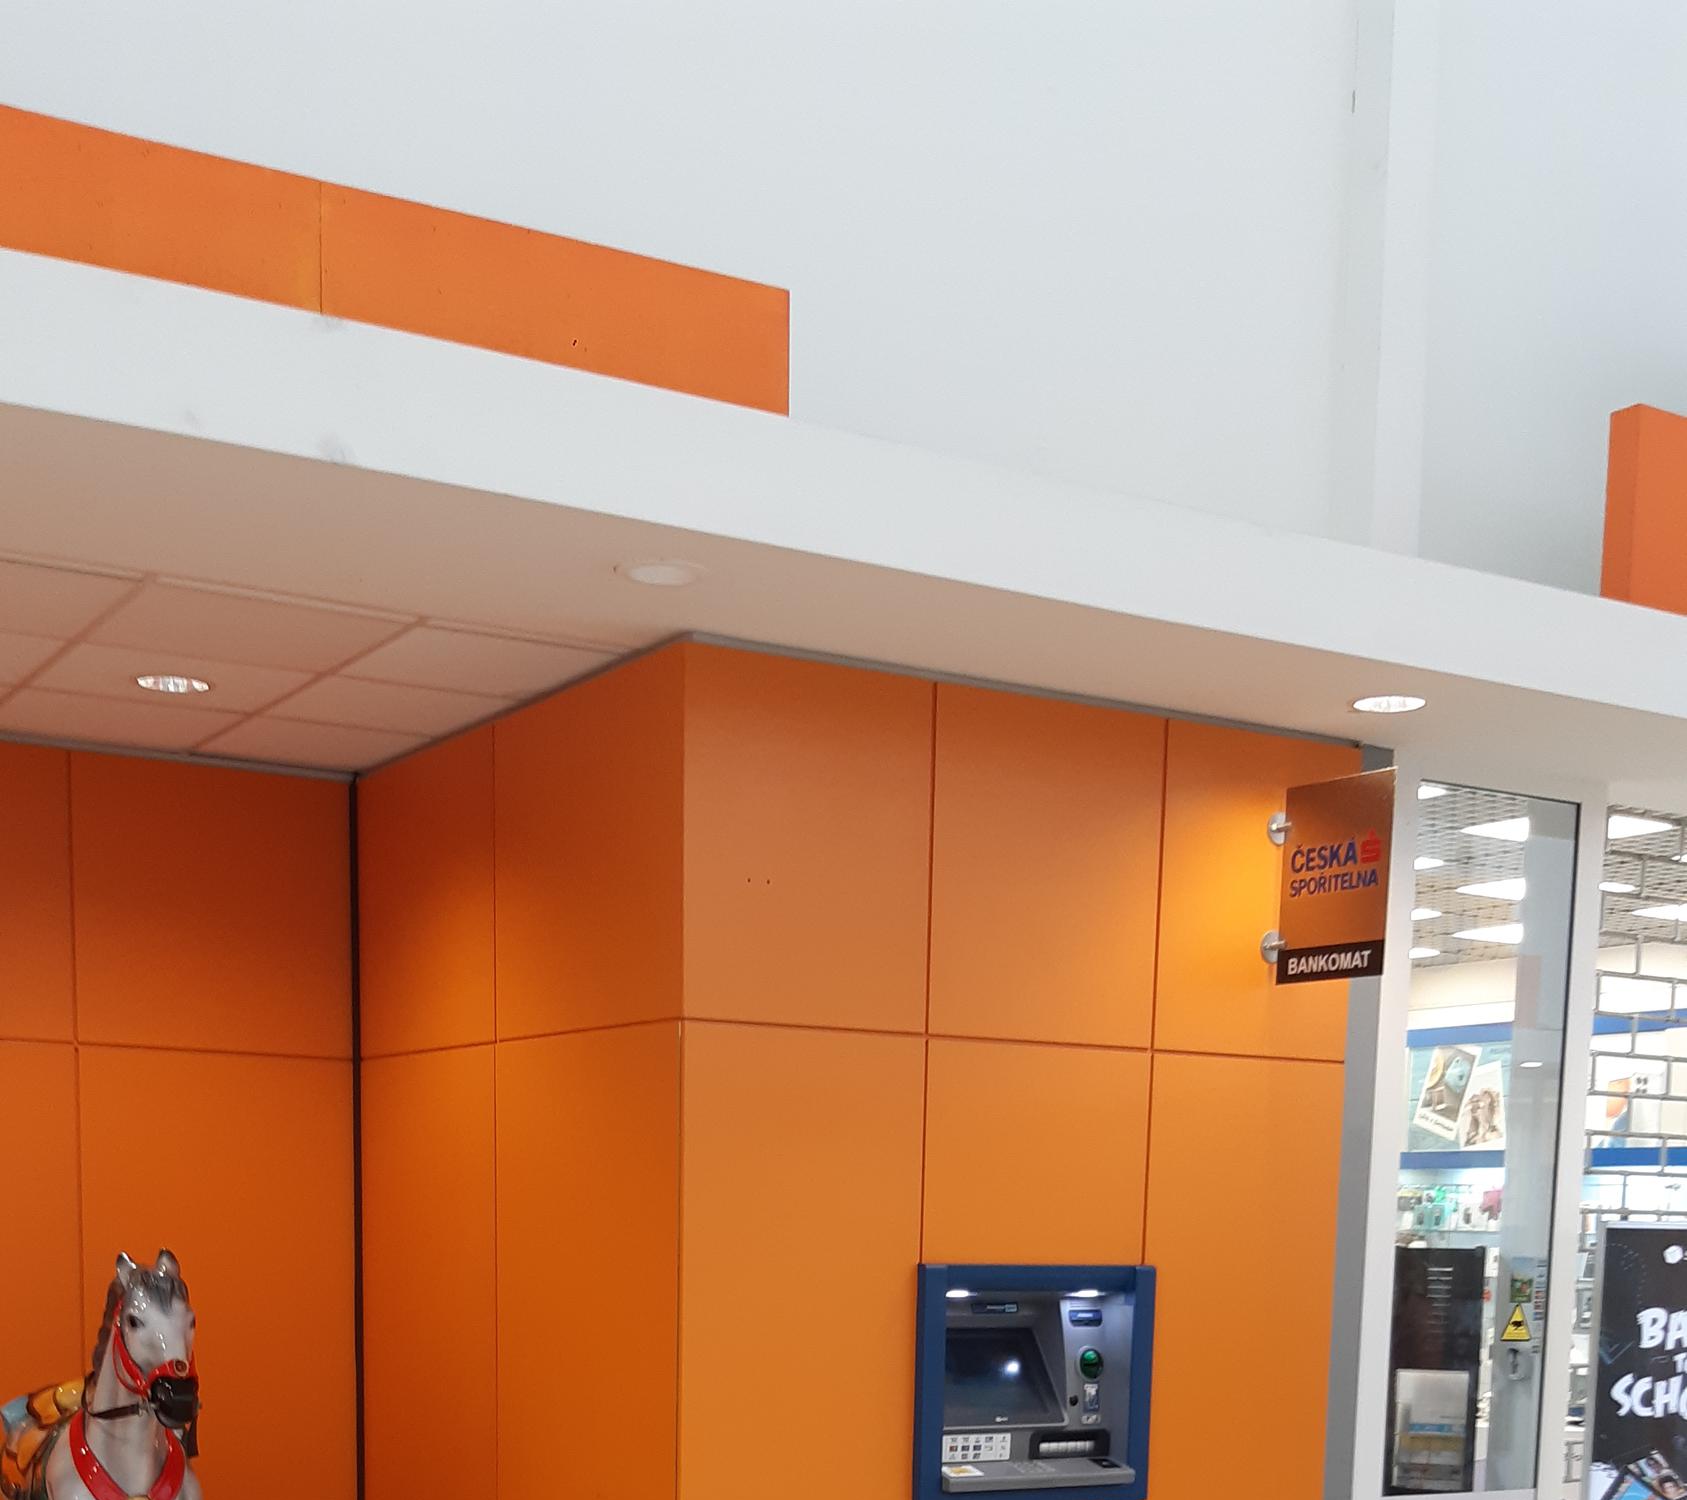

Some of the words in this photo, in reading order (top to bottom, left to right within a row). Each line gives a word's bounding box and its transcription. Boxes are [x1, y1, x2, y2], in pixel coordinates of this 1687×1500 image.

[1291, 838, 1358, 873] ČESKÁ
[1289, 869, 1379, 897] SPOŘITELNA
[1287, 949, 1372, 975] BANKOMAT
